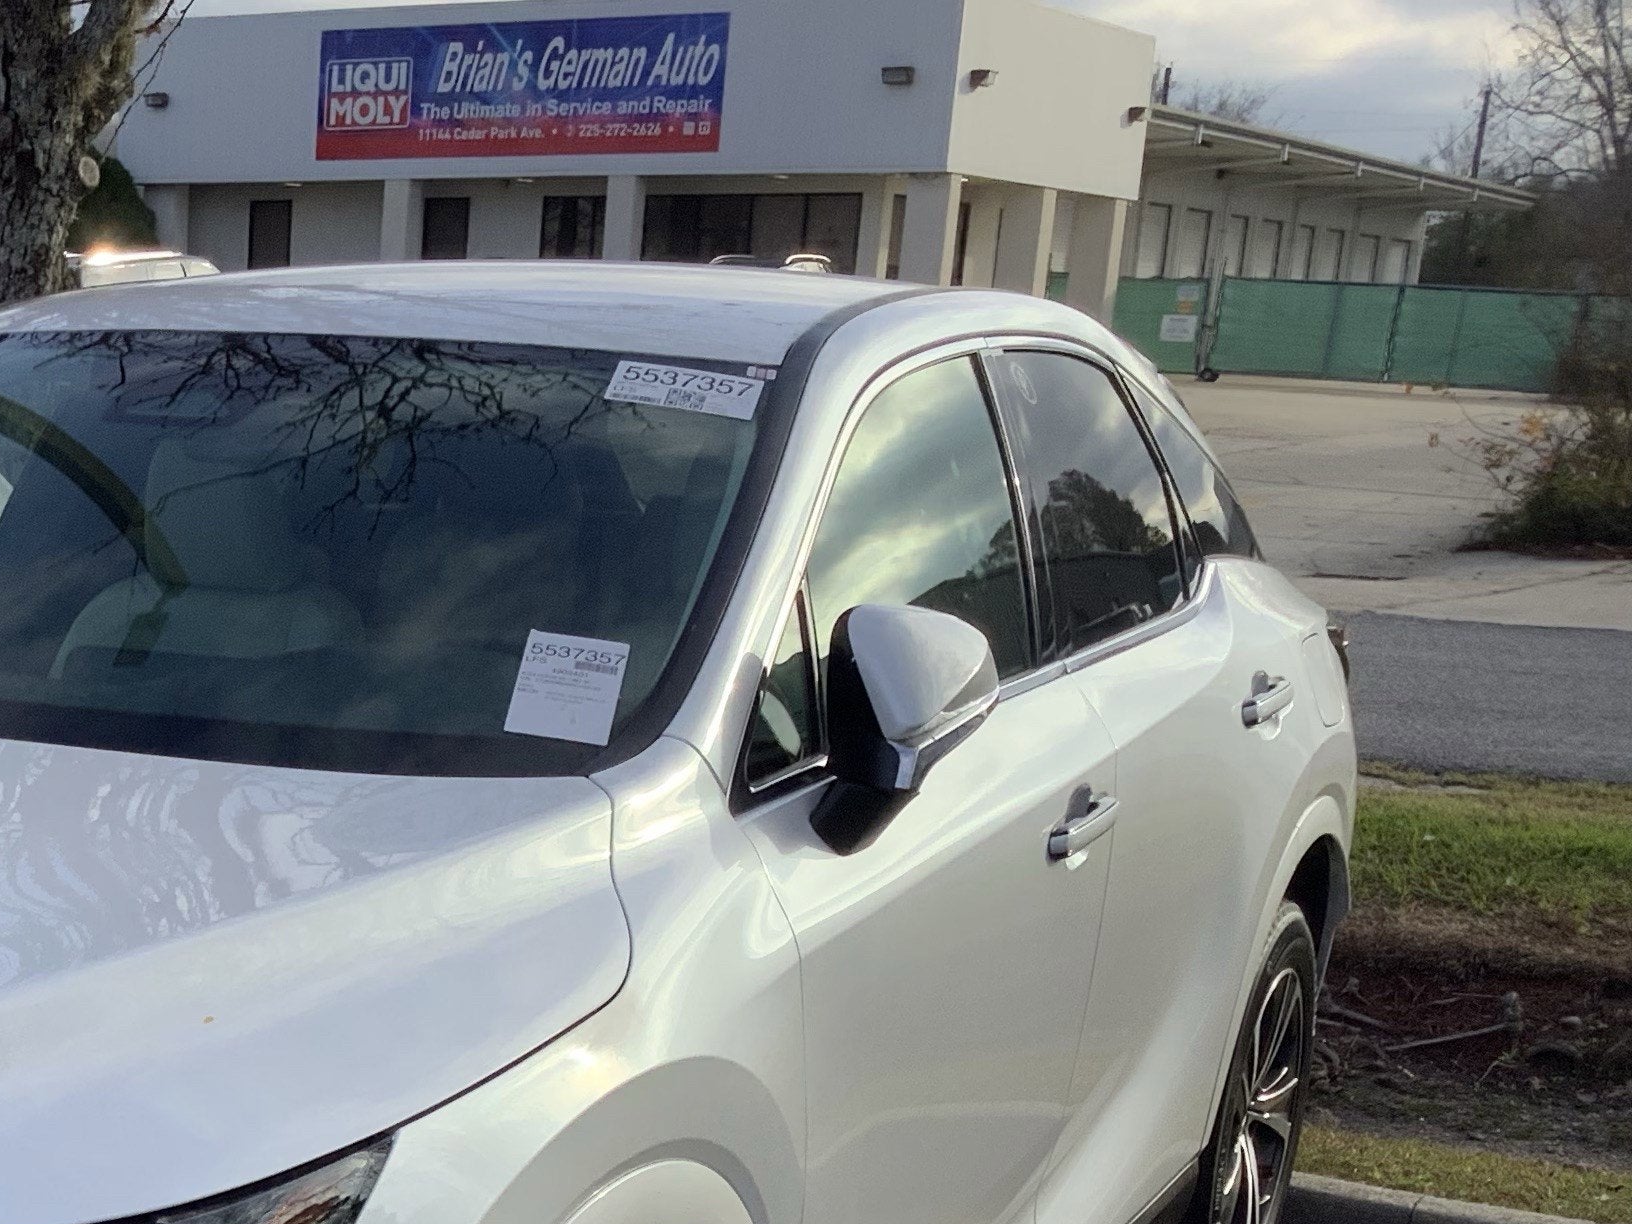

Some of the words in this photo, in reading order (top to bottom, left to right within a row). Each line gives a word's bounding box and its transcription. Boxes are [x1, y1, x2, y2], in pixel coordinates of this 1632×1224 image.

[331, 62, 408, 93] LIQUI
[436, 39, 533, 93] Brian's
[538, 36, 647, 90] German
[647, 32, 719, 86] Auto
[329, 95, 410, 126] MOLY
[420, 102, 450, 119] The
[453, 101, 521, 119] Ultimate
[526, 100, 542, 117] in
[546, 98, 612, 116] Service
[617, 97, 650, 114] and
[652, 95, 712, 117] Repair
[622, 365, 755, 396] 5537357
[531, 642, 626, 665] 5537357
